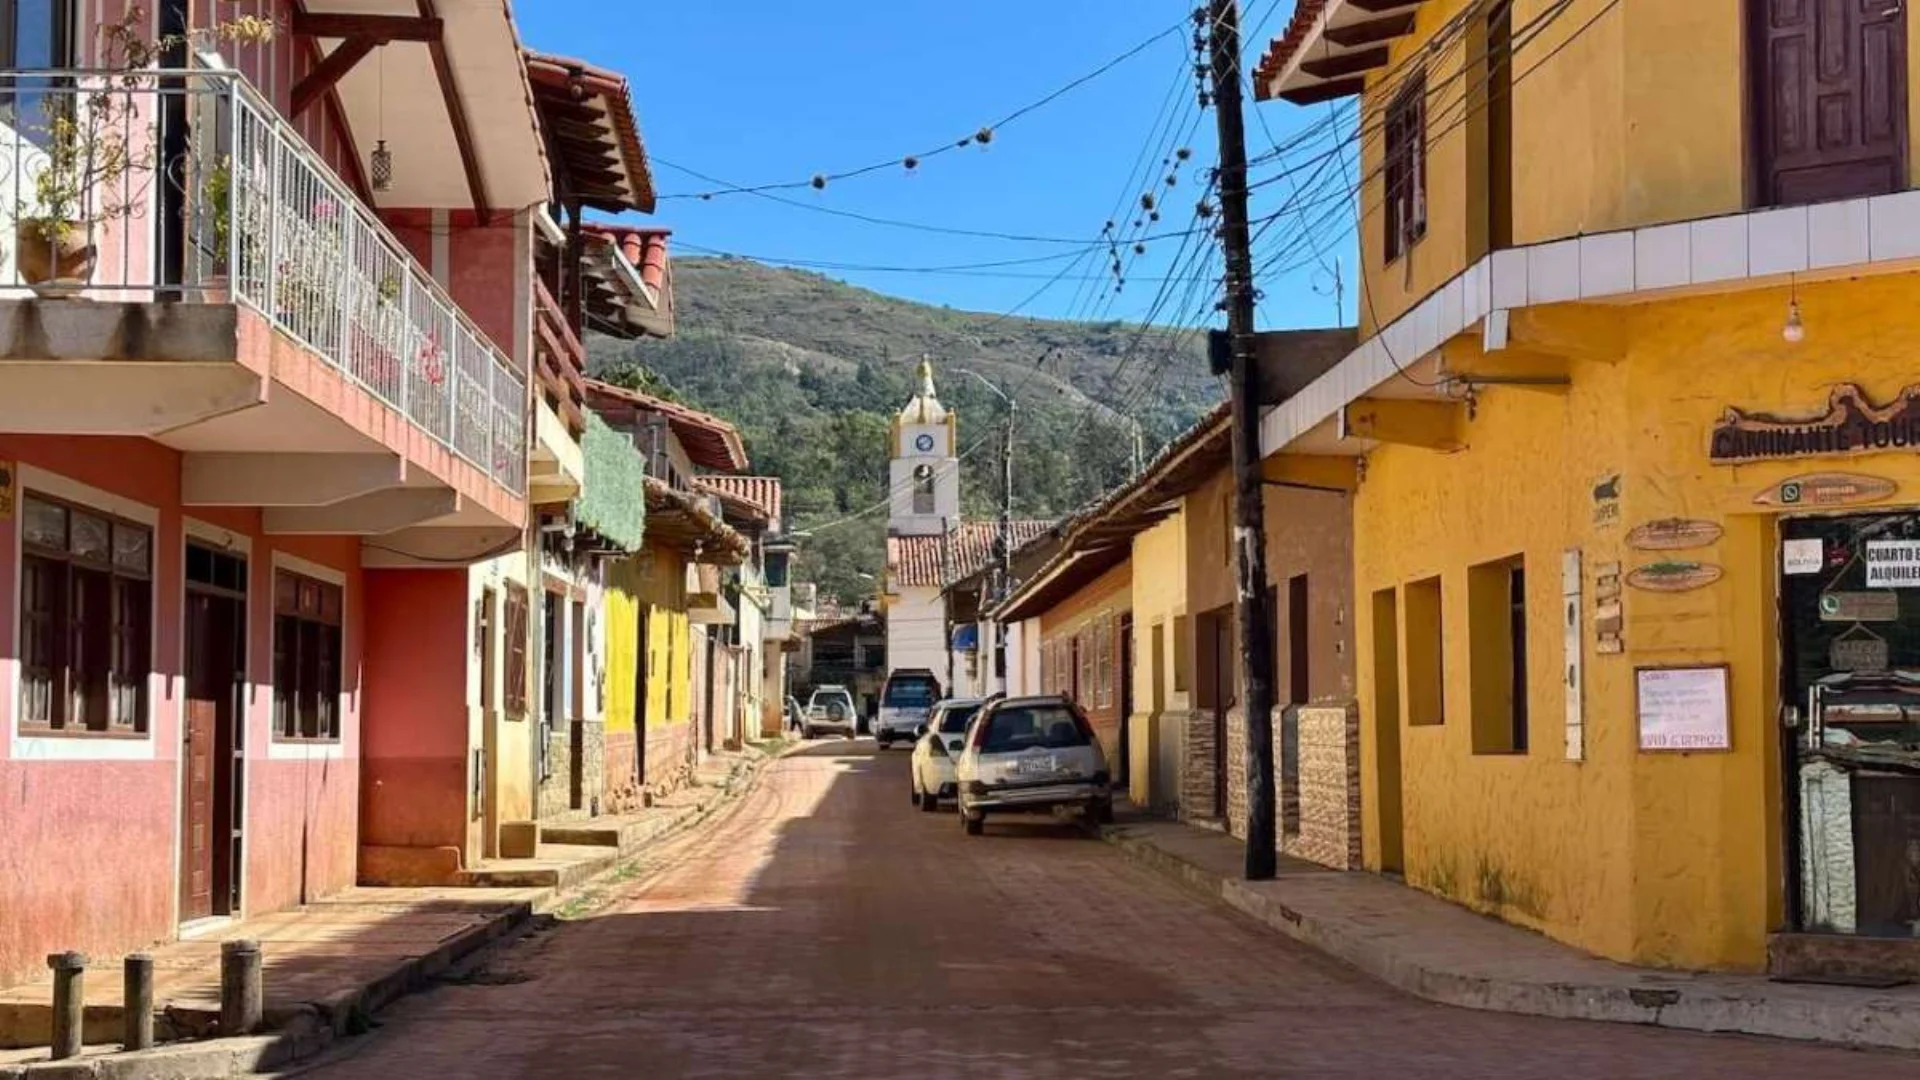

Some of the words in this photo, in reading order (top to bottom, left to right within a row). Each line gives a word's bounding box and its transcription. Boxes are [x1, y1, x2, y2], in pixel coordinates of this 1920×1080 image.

[1716, 424, 1850, 457] CAMINANTE
[1868, 547, 1912, 562] CUARTO
[1870, 565, 1920, 581] ALQUILE
